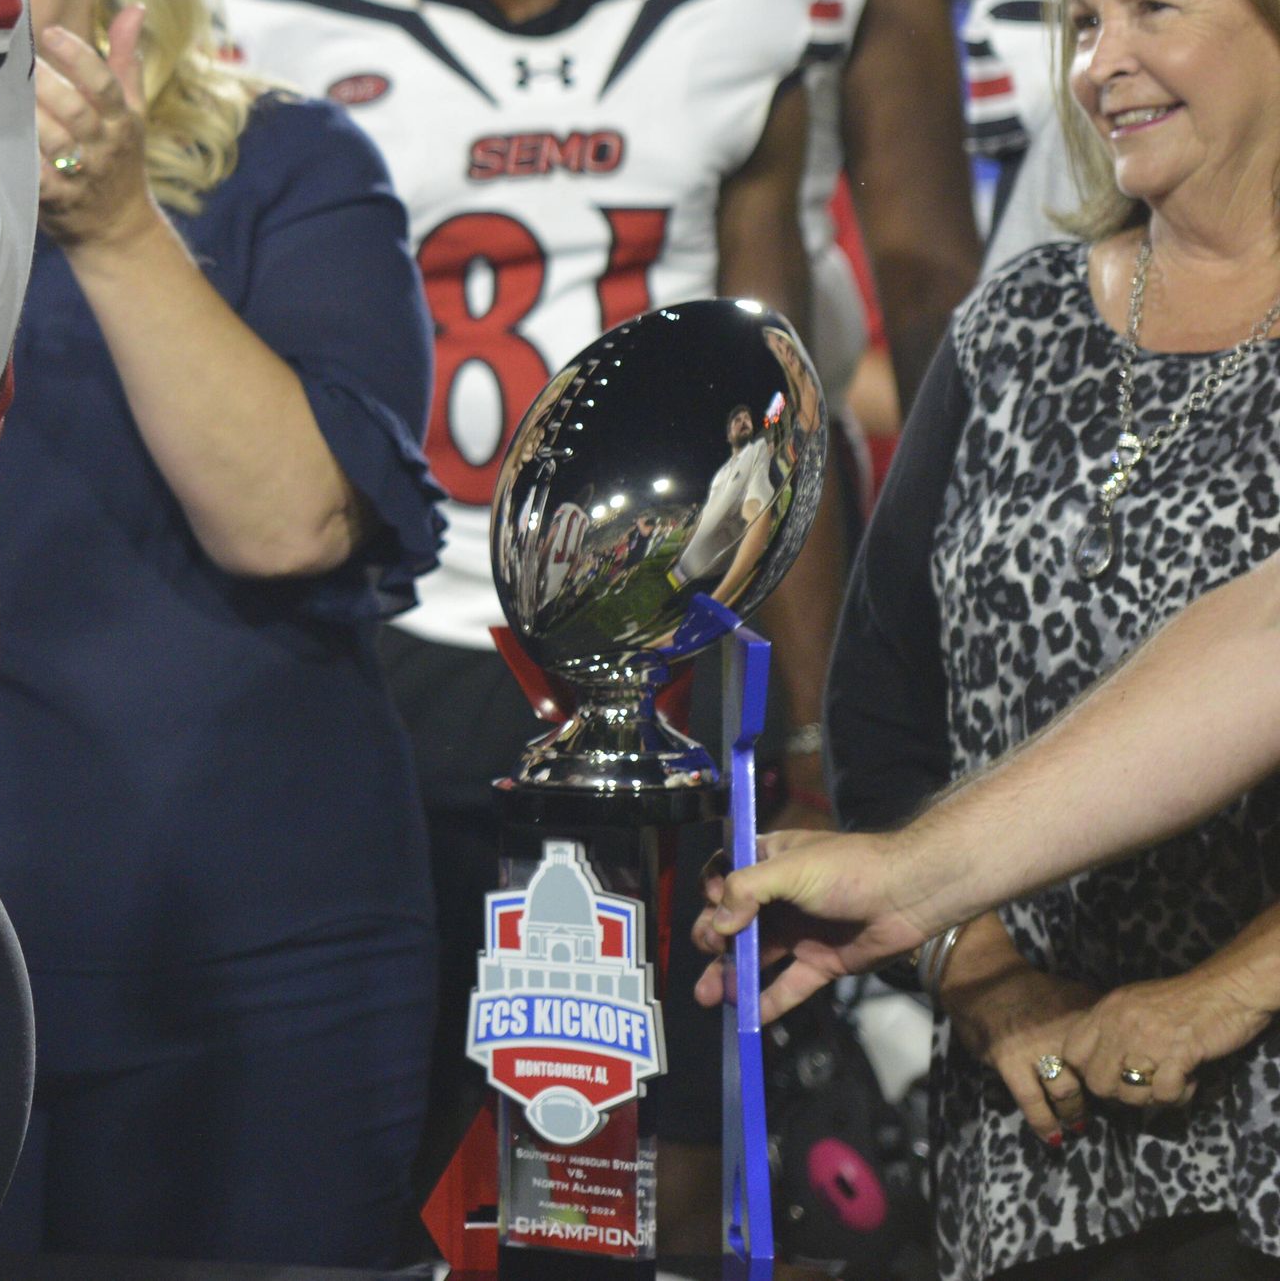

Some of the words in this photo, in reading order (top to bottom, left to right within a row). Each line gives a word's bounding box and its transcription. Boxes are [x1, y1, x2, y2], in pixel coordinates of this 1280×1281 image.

[467, 130, 627, 183] SEMO
[416, 205, 675, 508] 81
[477, 997, 529, 1040] FCS
[533, 998, 646, 1052] KICKOFF
[513, 1058, 593, 1085] MONTGOMERY,
[594, 1065, 610, 1086] AL
[514, 1215, 638, 1247] CHAMPION
